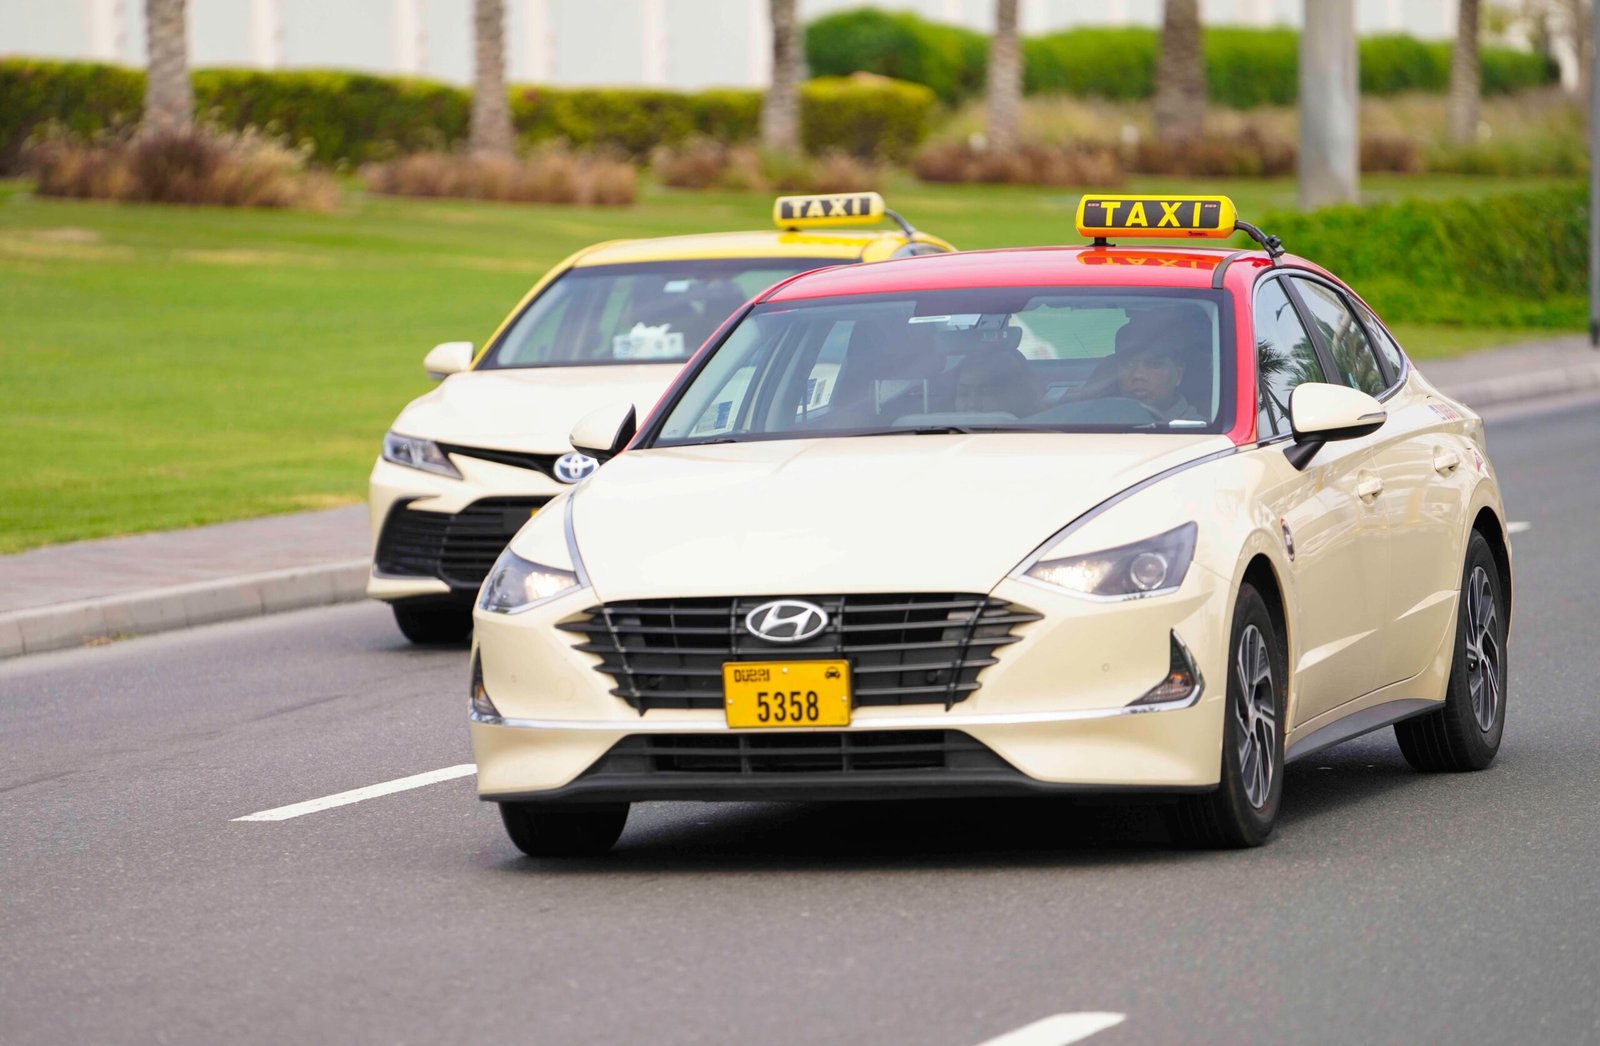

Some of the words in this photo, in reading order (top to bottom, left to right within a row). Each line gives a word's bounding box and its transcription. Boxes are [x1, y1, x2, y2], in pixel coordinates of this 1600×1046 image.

[788, 198, 861, 217] TAXI
[1100, 202, 1202, 227] TAXI
[733, 668, 770, 683] DUBAI
[757, 691, 819, 722] 5358
